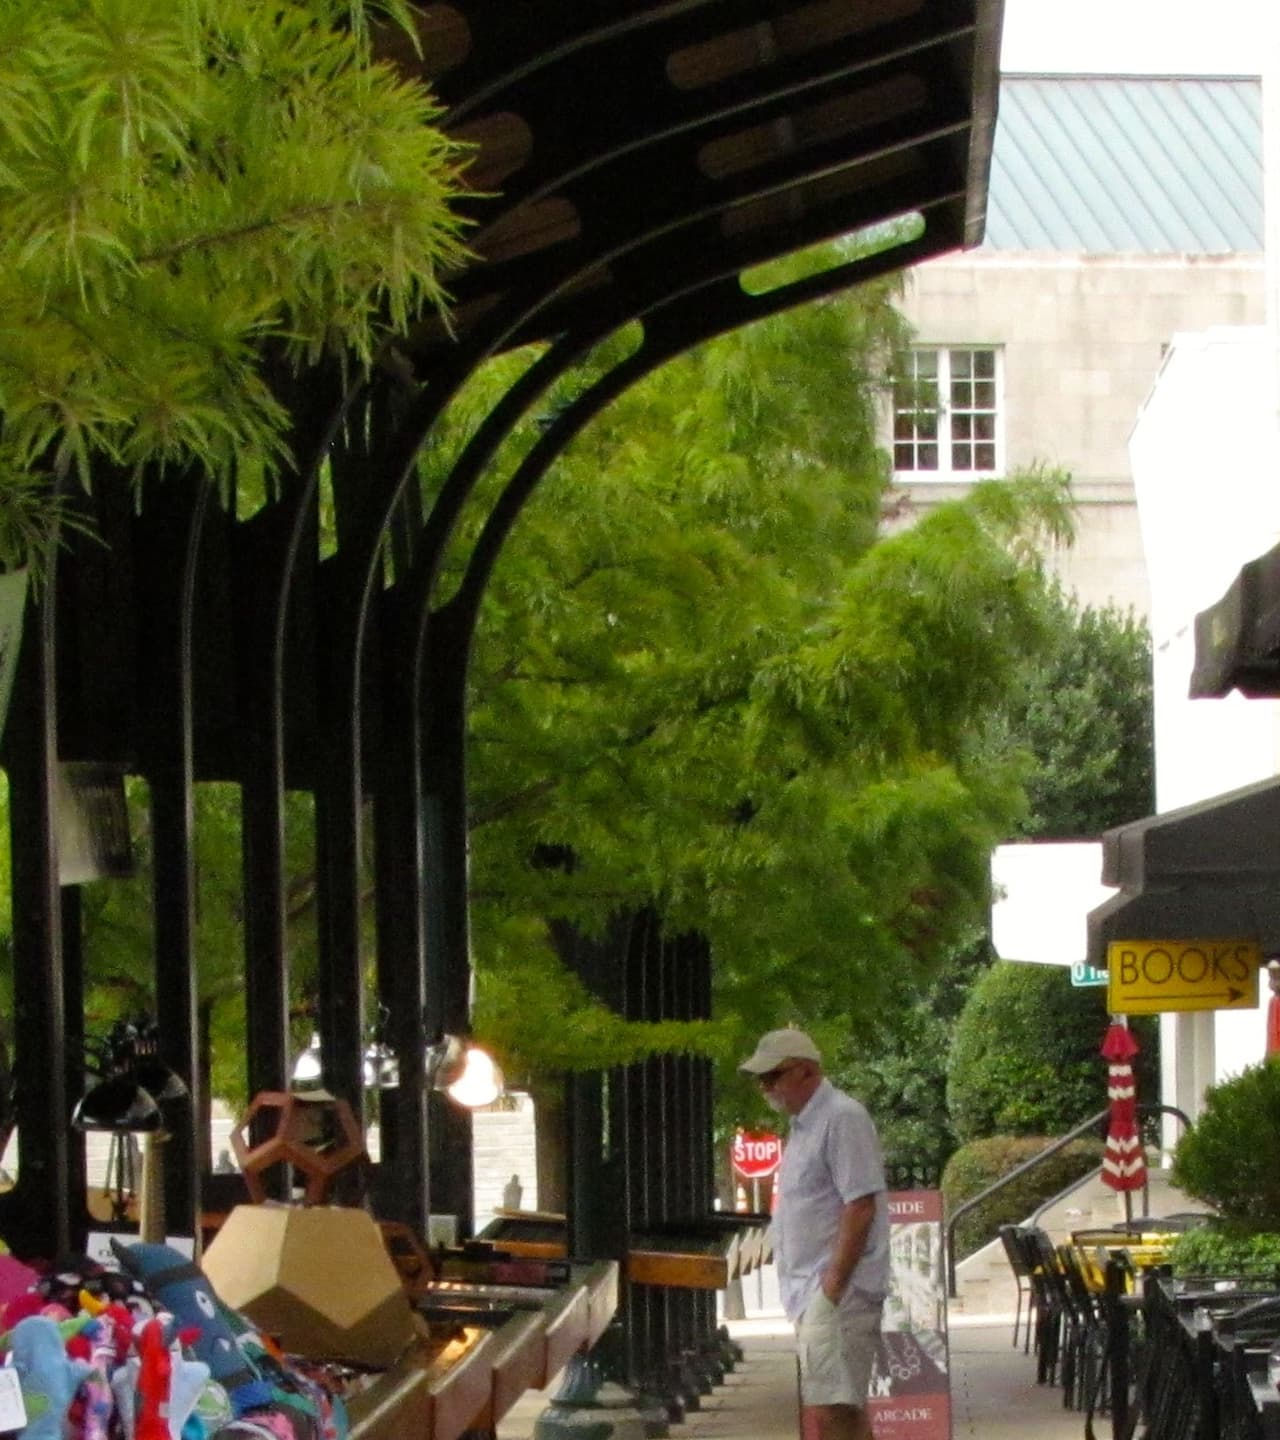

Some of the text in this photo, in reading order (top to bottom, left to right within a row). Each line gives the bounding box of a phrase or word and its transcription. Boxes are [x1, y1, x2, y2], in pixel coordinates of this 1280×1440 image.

[1120, 946, 1250, 986] BOOKS
[734, 1141, 777, 1163] STOP
[873, 1407, 934, 1423] ARCADE
